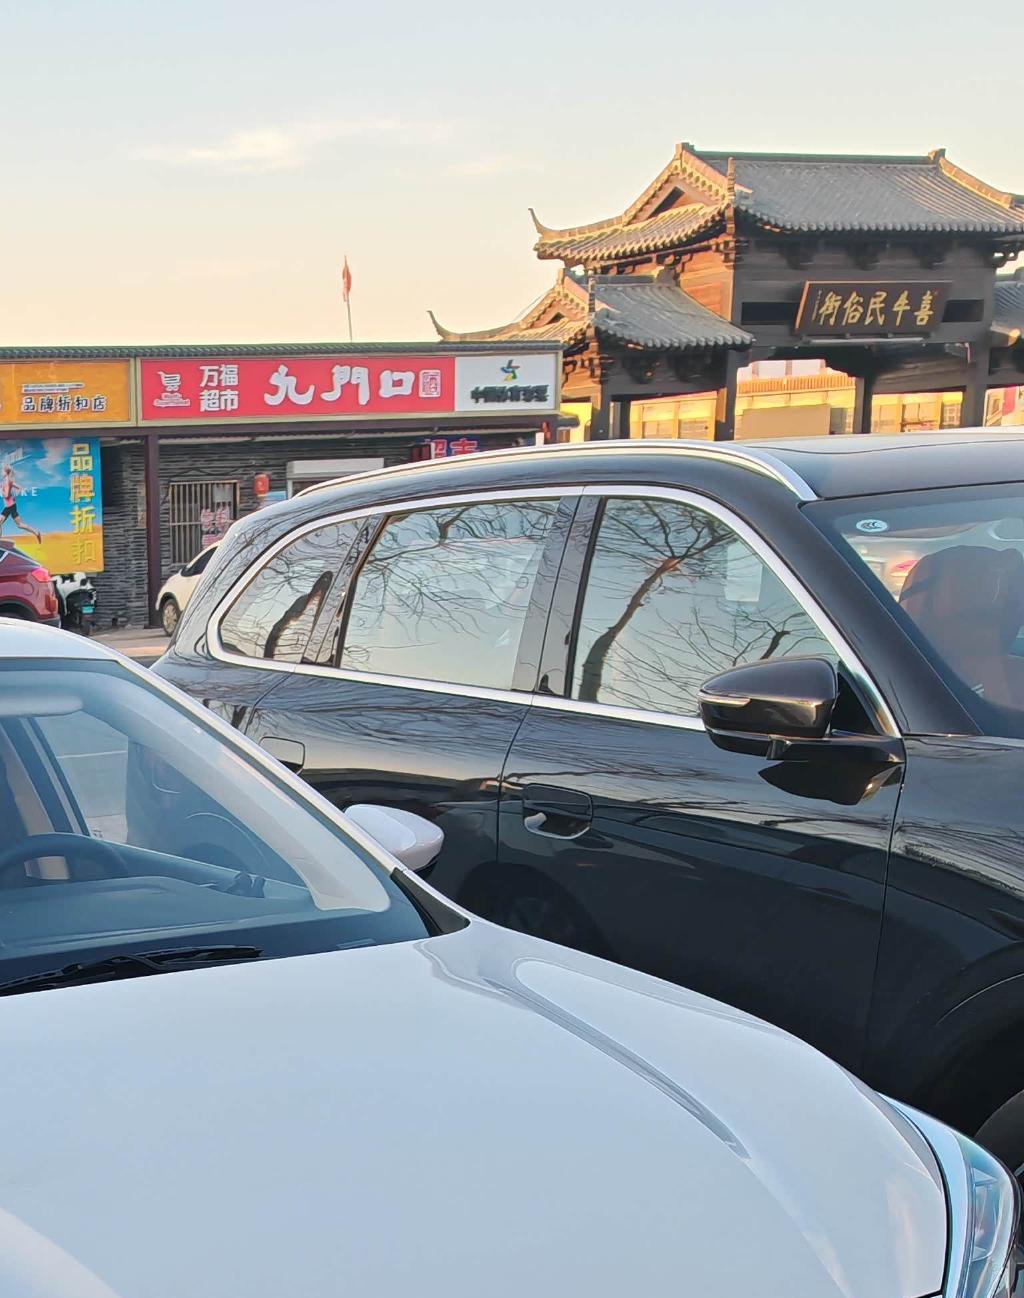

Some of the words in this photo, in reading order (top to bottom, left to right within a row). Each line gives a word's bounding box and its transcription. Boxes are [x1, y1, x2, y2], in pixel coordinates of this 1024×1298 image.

[199, 364, 239, 388] 万福
[22, 394, 107, 412] 品牌折扣店
[199, 389, 239, 412] 超市
[70, 443, 97, 565] 品牌折扣
